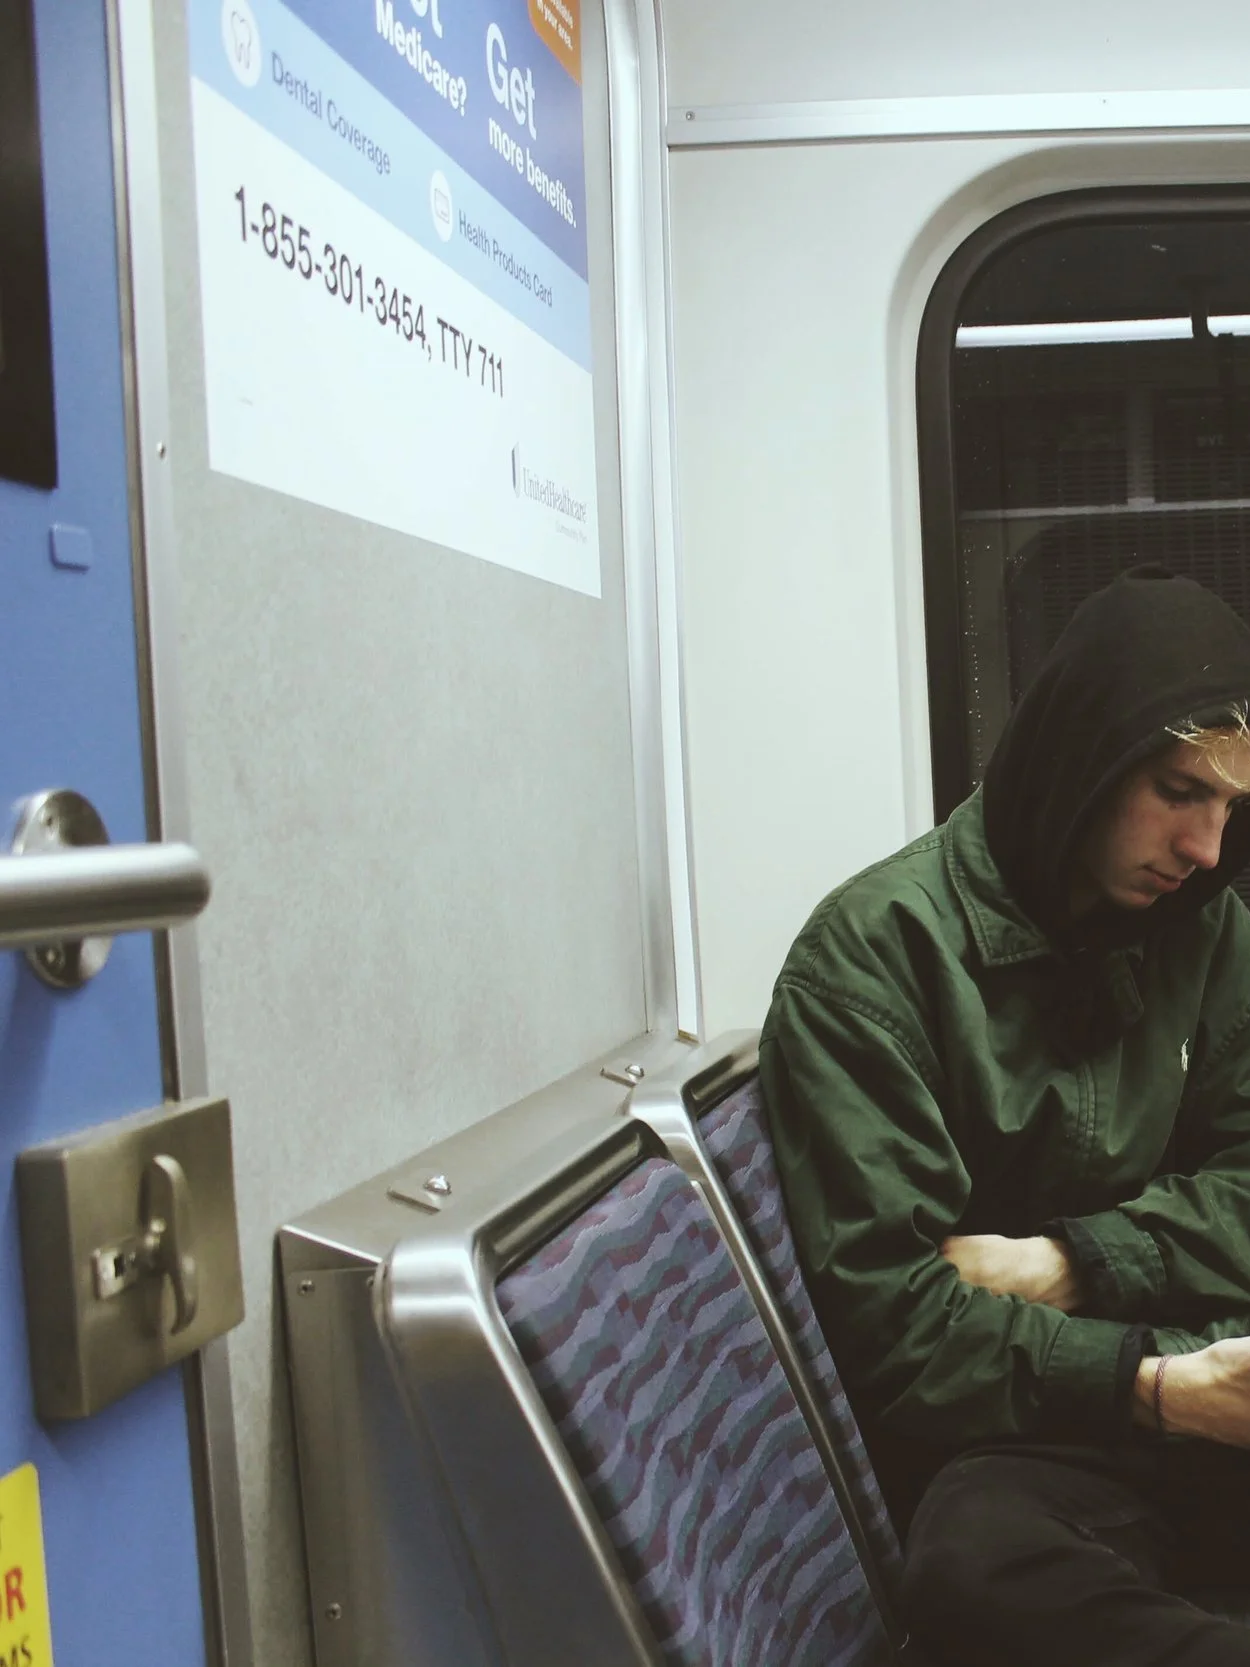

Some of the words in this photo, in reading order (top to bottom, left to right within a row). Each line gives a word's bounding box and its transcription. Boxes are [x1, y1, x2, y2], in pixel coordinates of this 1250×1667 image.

[272, 52, 322, 120] Dental
[327, 100, 391, 176] Coverage
[375, 0, 467, 116] Medicare?
[486, 22, 537, 140] Get
[489, 117, 524, 174] more
[526, 161, 577, 228] benefits.
[235, 185, 432, 361] 1-855-301-3454,
[437, 316, 473, 377] TTY
[478, 344, 503, 398] 711
[458, 209, 490, 253] Health
[493, 234, 532, 291] Products
[533, 276, 553, 308] Card
[0, 1565, 25, 1621] R
